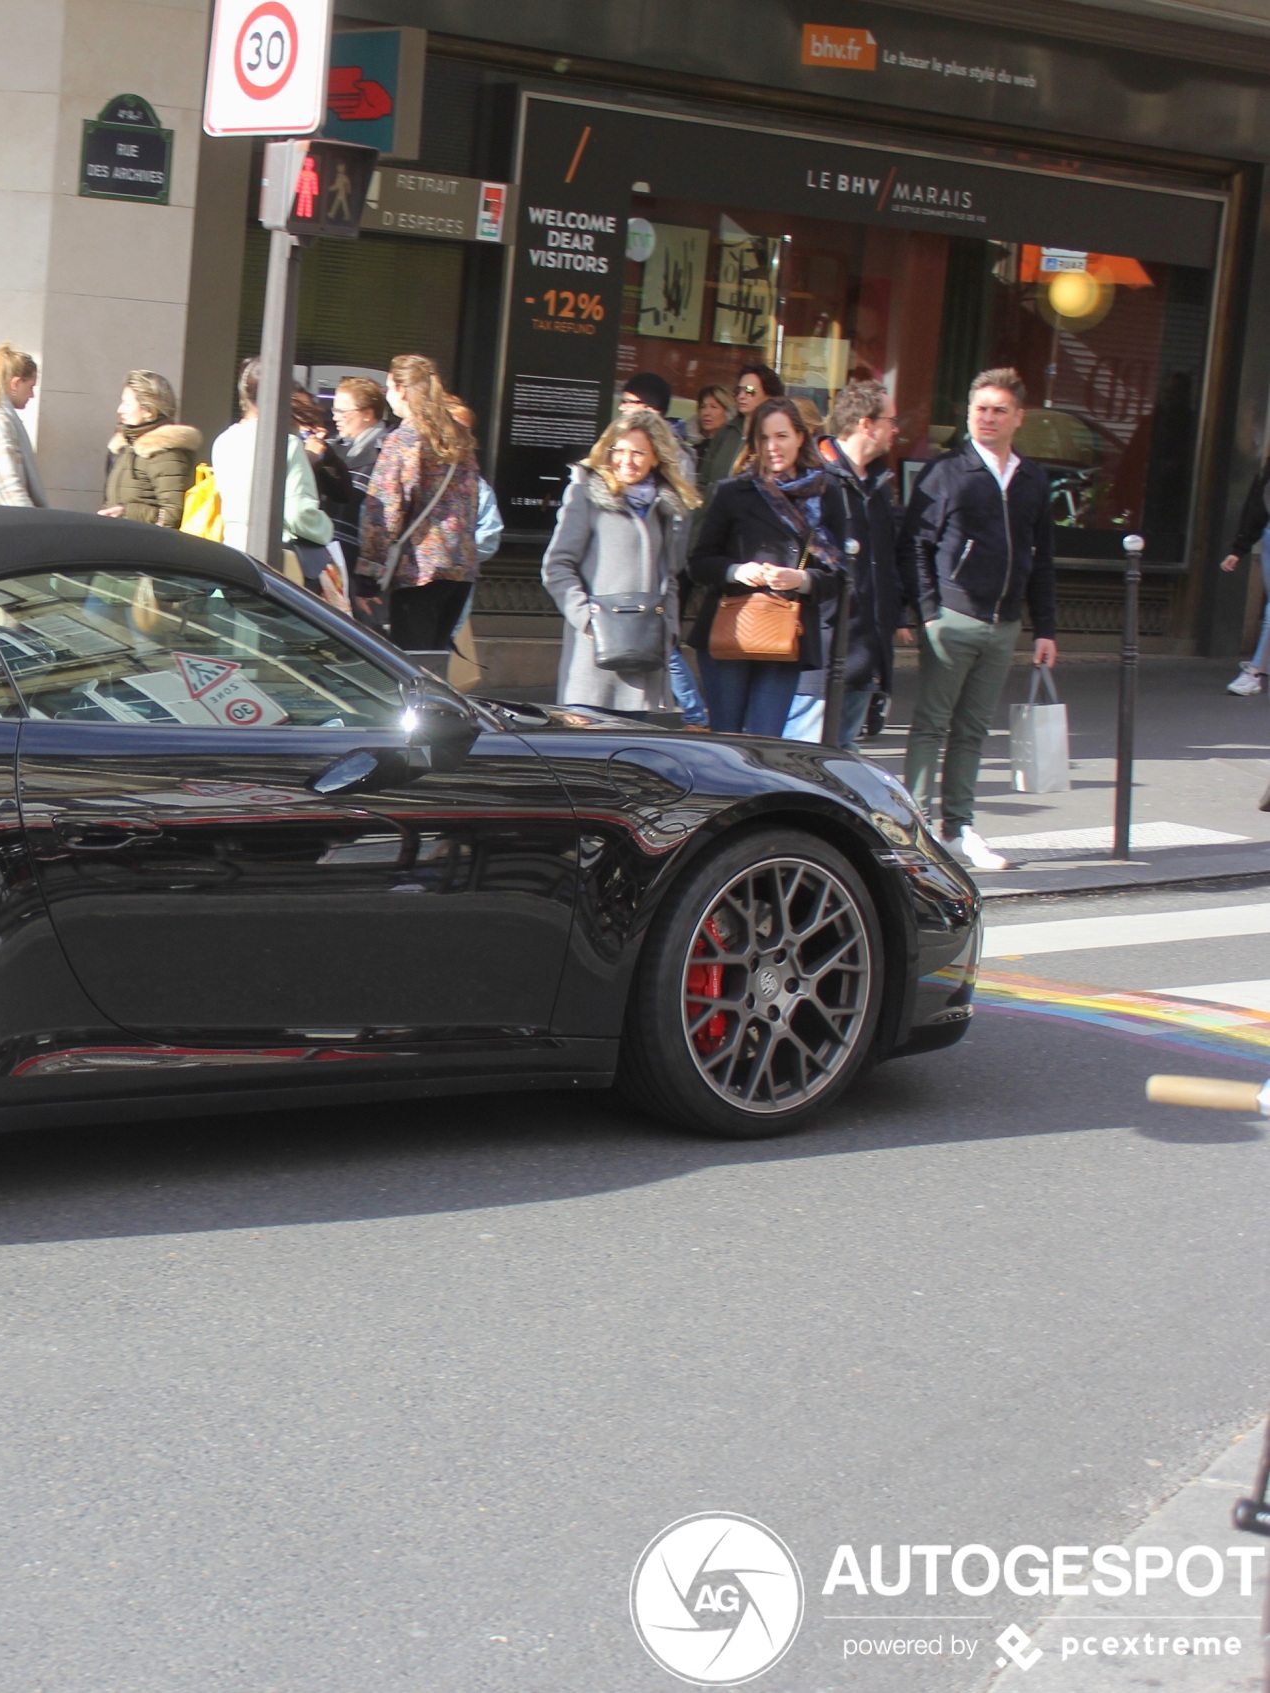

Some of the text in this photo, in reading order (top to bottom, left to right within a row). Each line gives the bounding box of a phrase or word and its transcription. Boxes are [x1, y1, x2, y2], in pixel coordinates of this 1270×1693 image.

[247, 31, 285, 71] 30
[810, 34, 862, 61] bhv.fr
[883, 49, 897, 64] Le
[899, 51, 930, 69] bazar
[931, 57, 942, 72] le
[943, 60, 968, 77] plus
[996, 69, 1012, 84] du
[1013, 74, 1037, 88] web
[115, 142, 139, 158] RUE
[86, 163, 165, 184] DES ARCHIVES
[396, 174, 459, 195] RETRAIT
[806, 170, 973, 209] LE BHV MARAIS
[528, 207, 617, 233] WELCOME
[547, 230, 595, 252] DEAR
[528, 249, 609, 274] VISITORS
[531, 318, 597, 335] TAX REFUND
